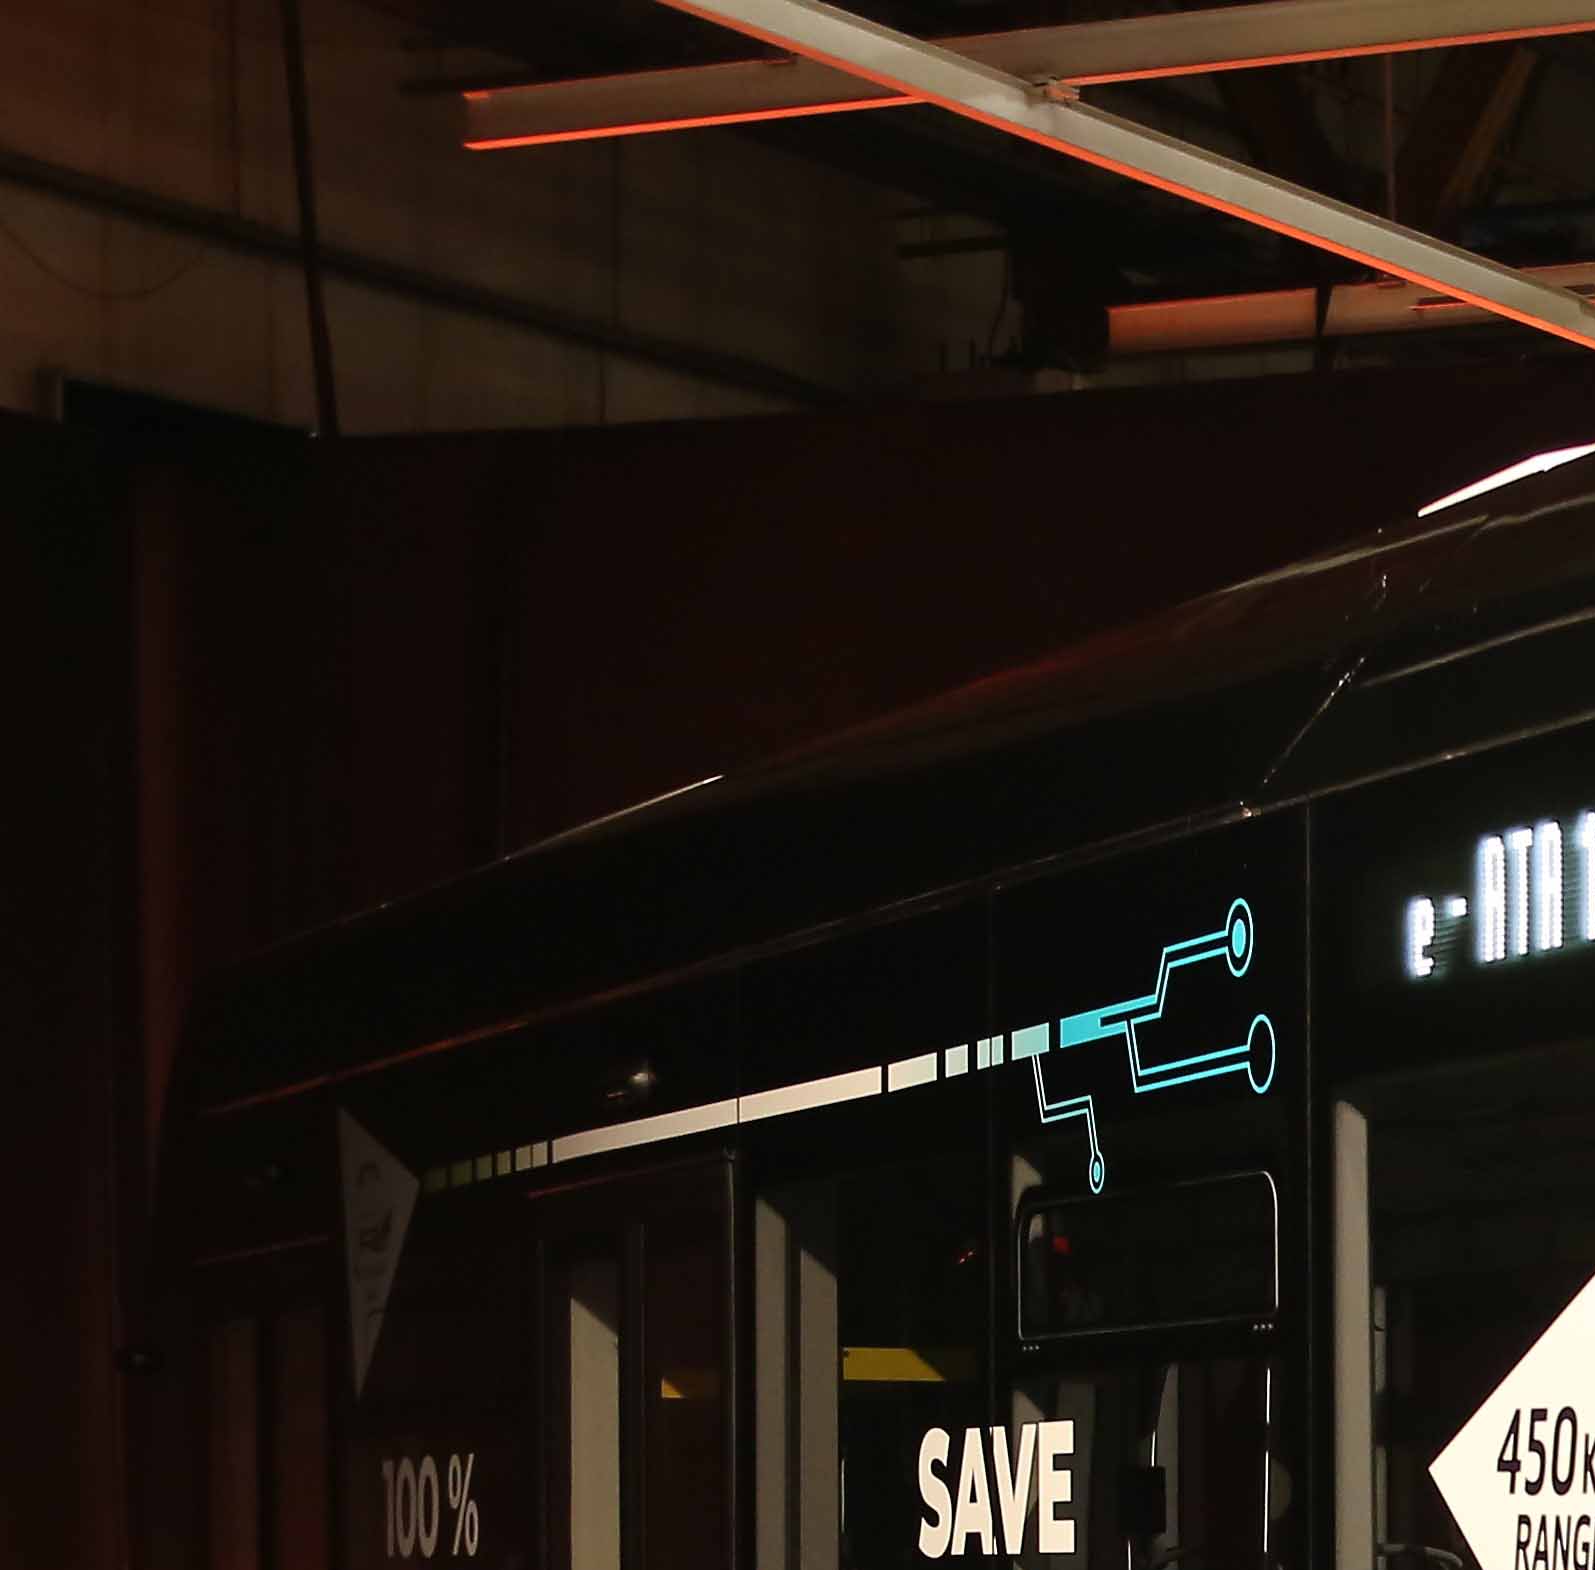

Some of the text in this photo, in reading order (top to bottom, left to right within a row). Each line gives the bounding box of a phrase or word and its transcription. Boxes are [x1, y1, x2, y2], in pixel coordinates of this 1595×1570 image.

[1404, 820, 1563, 977] e-ATA
[382, 1453, 479, 1558] 100 %
[918, 1420, 1075, 1558] SAVE
[1497, 1406, 1577, 1496] 450
